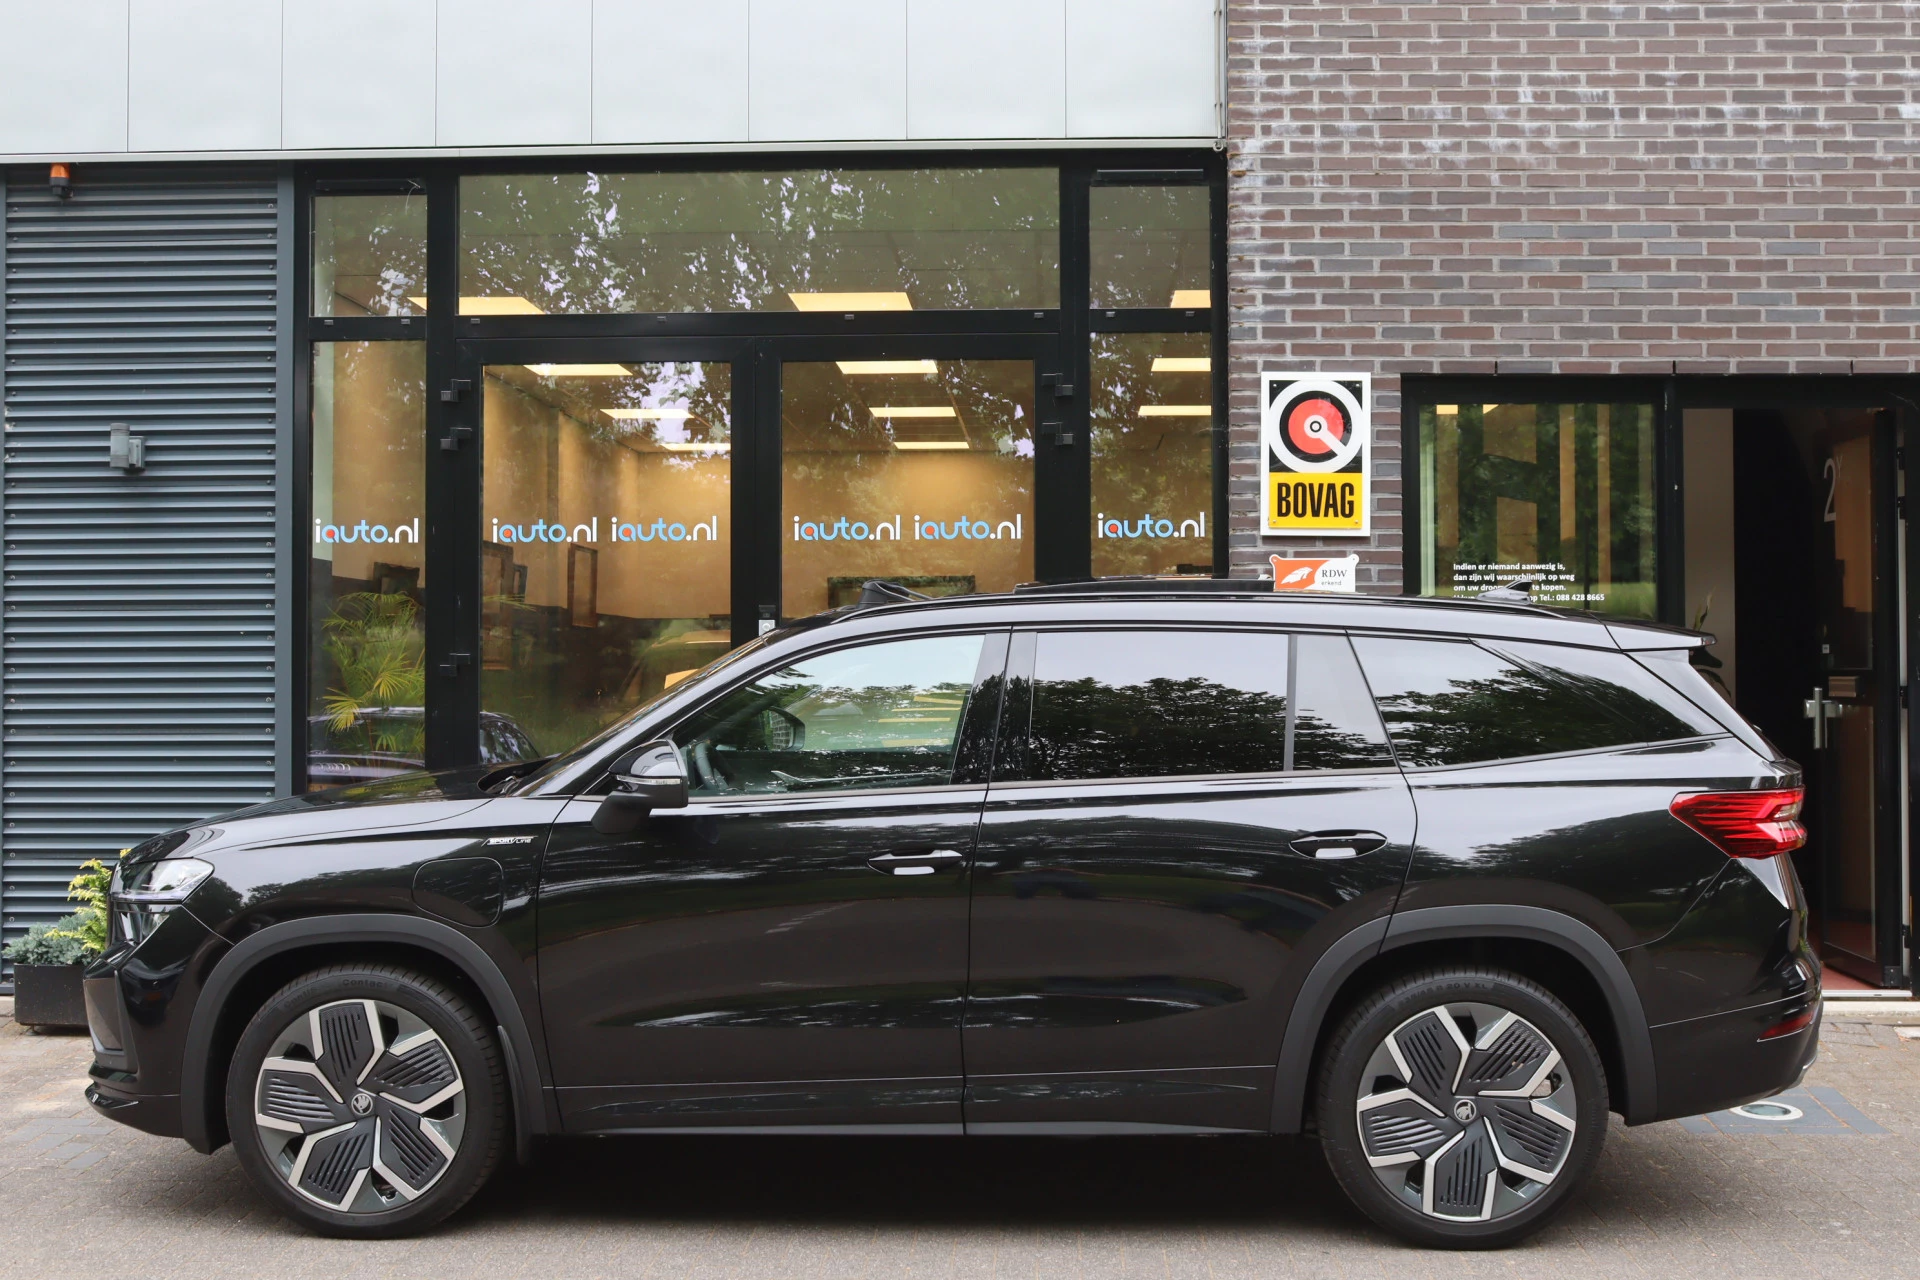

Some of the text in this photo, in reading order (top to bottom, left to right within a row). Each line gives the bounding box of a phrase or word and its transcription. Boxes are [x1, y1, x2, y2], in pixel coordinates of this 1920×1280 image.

[1277, 482, 1355, 519] BOVAG
[315, 518, 419, 544] iauto.nl
[492, 515, 717, 544] iauto.nl iauto.nl
[793, 514, 1022, 541] iauto.nl iauto.nl
[1097, 512, 1206, 539] iauto.nl
[1321, 569, 1348, 578] RDW
[1453, 563, 1477, 571] Indien
[1487, 562, 1520, 570] niemand
[1521, 562, 1556, 571] aanwezig
[1557, 562, 1566, 571] is,
[1453, 573, 1468, 581] dan
[1469, 573, 1482, 582] zijn
[1483, 573, 1495, 582] wij
[1547, 574, 1558, 582] op
[1559, 574, 1575, 582] weg
[1541, 583, 1567, 592] kopen.
[1539, 593, 1555, 602] Tel.:
[1555, 593, 1570, 601] 088
[1571, 593, 1585, 601] 428
[1586, 593, 1605, 601] 8665
